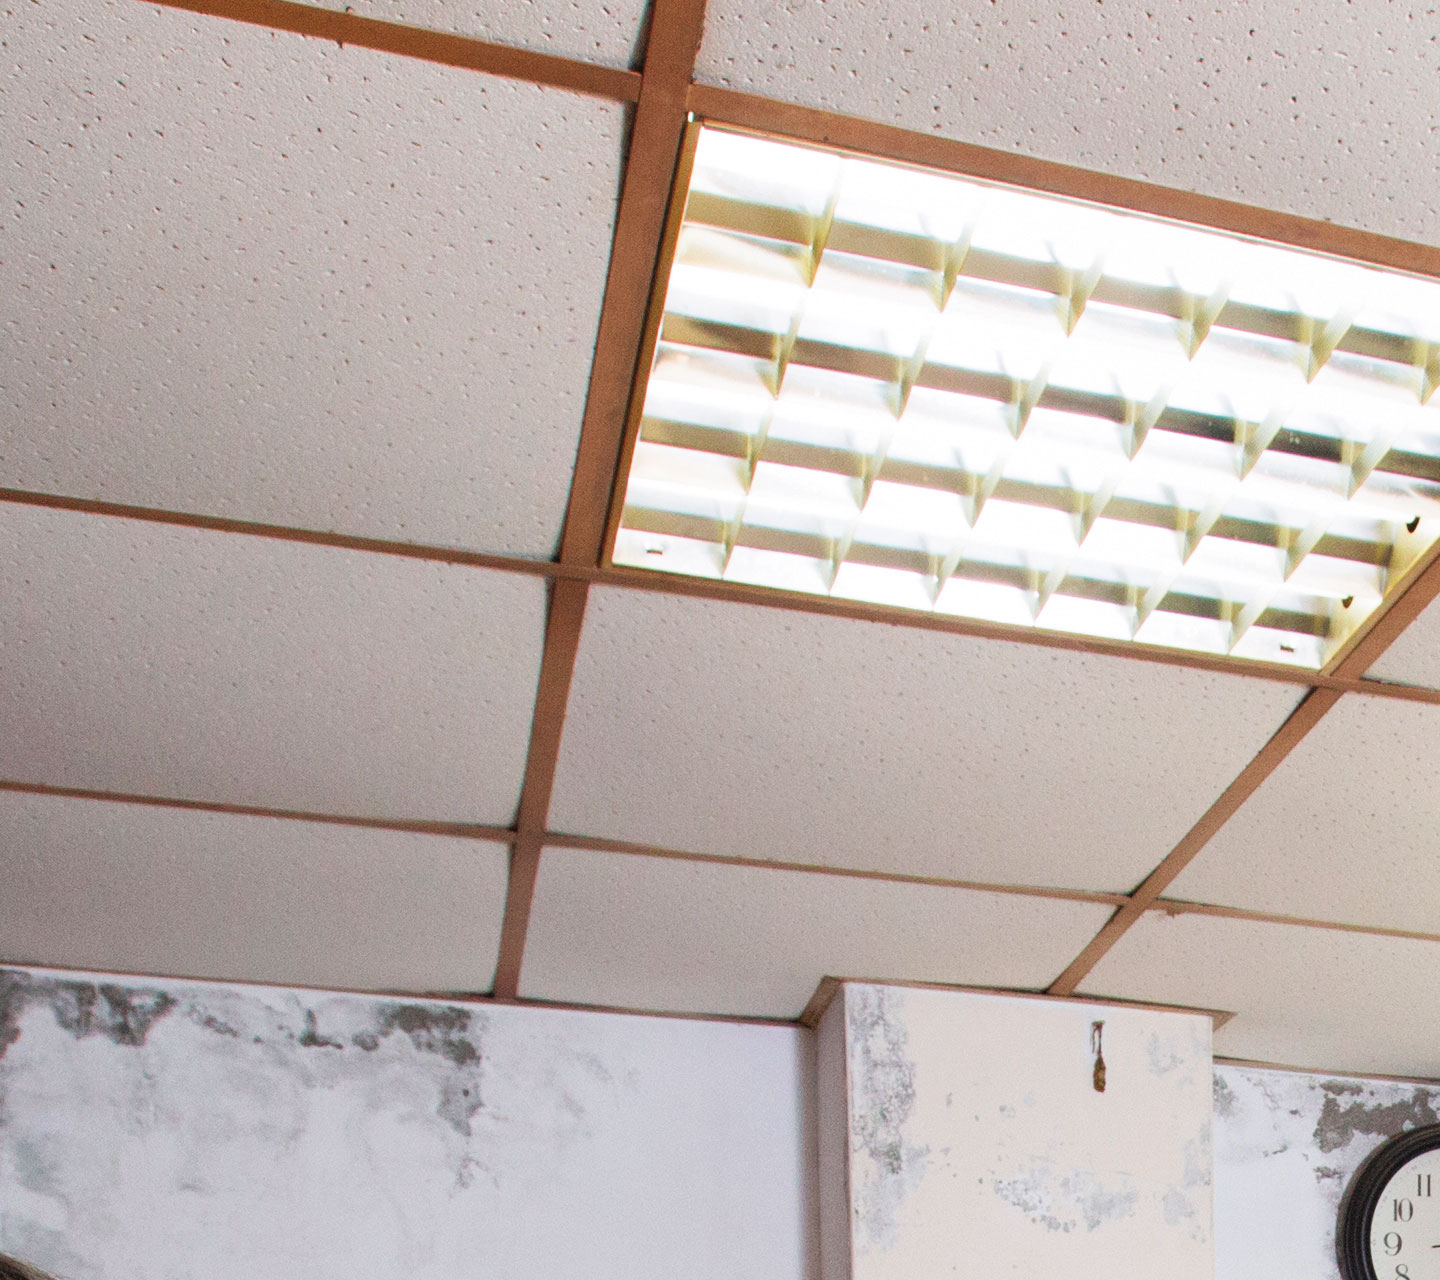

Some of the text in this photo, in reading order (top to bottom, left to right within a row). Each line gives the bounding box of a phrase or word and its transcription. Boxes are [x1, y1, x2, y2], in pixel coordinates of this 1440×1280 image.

[1416, 1174, 1432, 1198] 11
[1392, 1198, 1414, 1222] 10
[1384, 1232, 1403, 1256] 9
